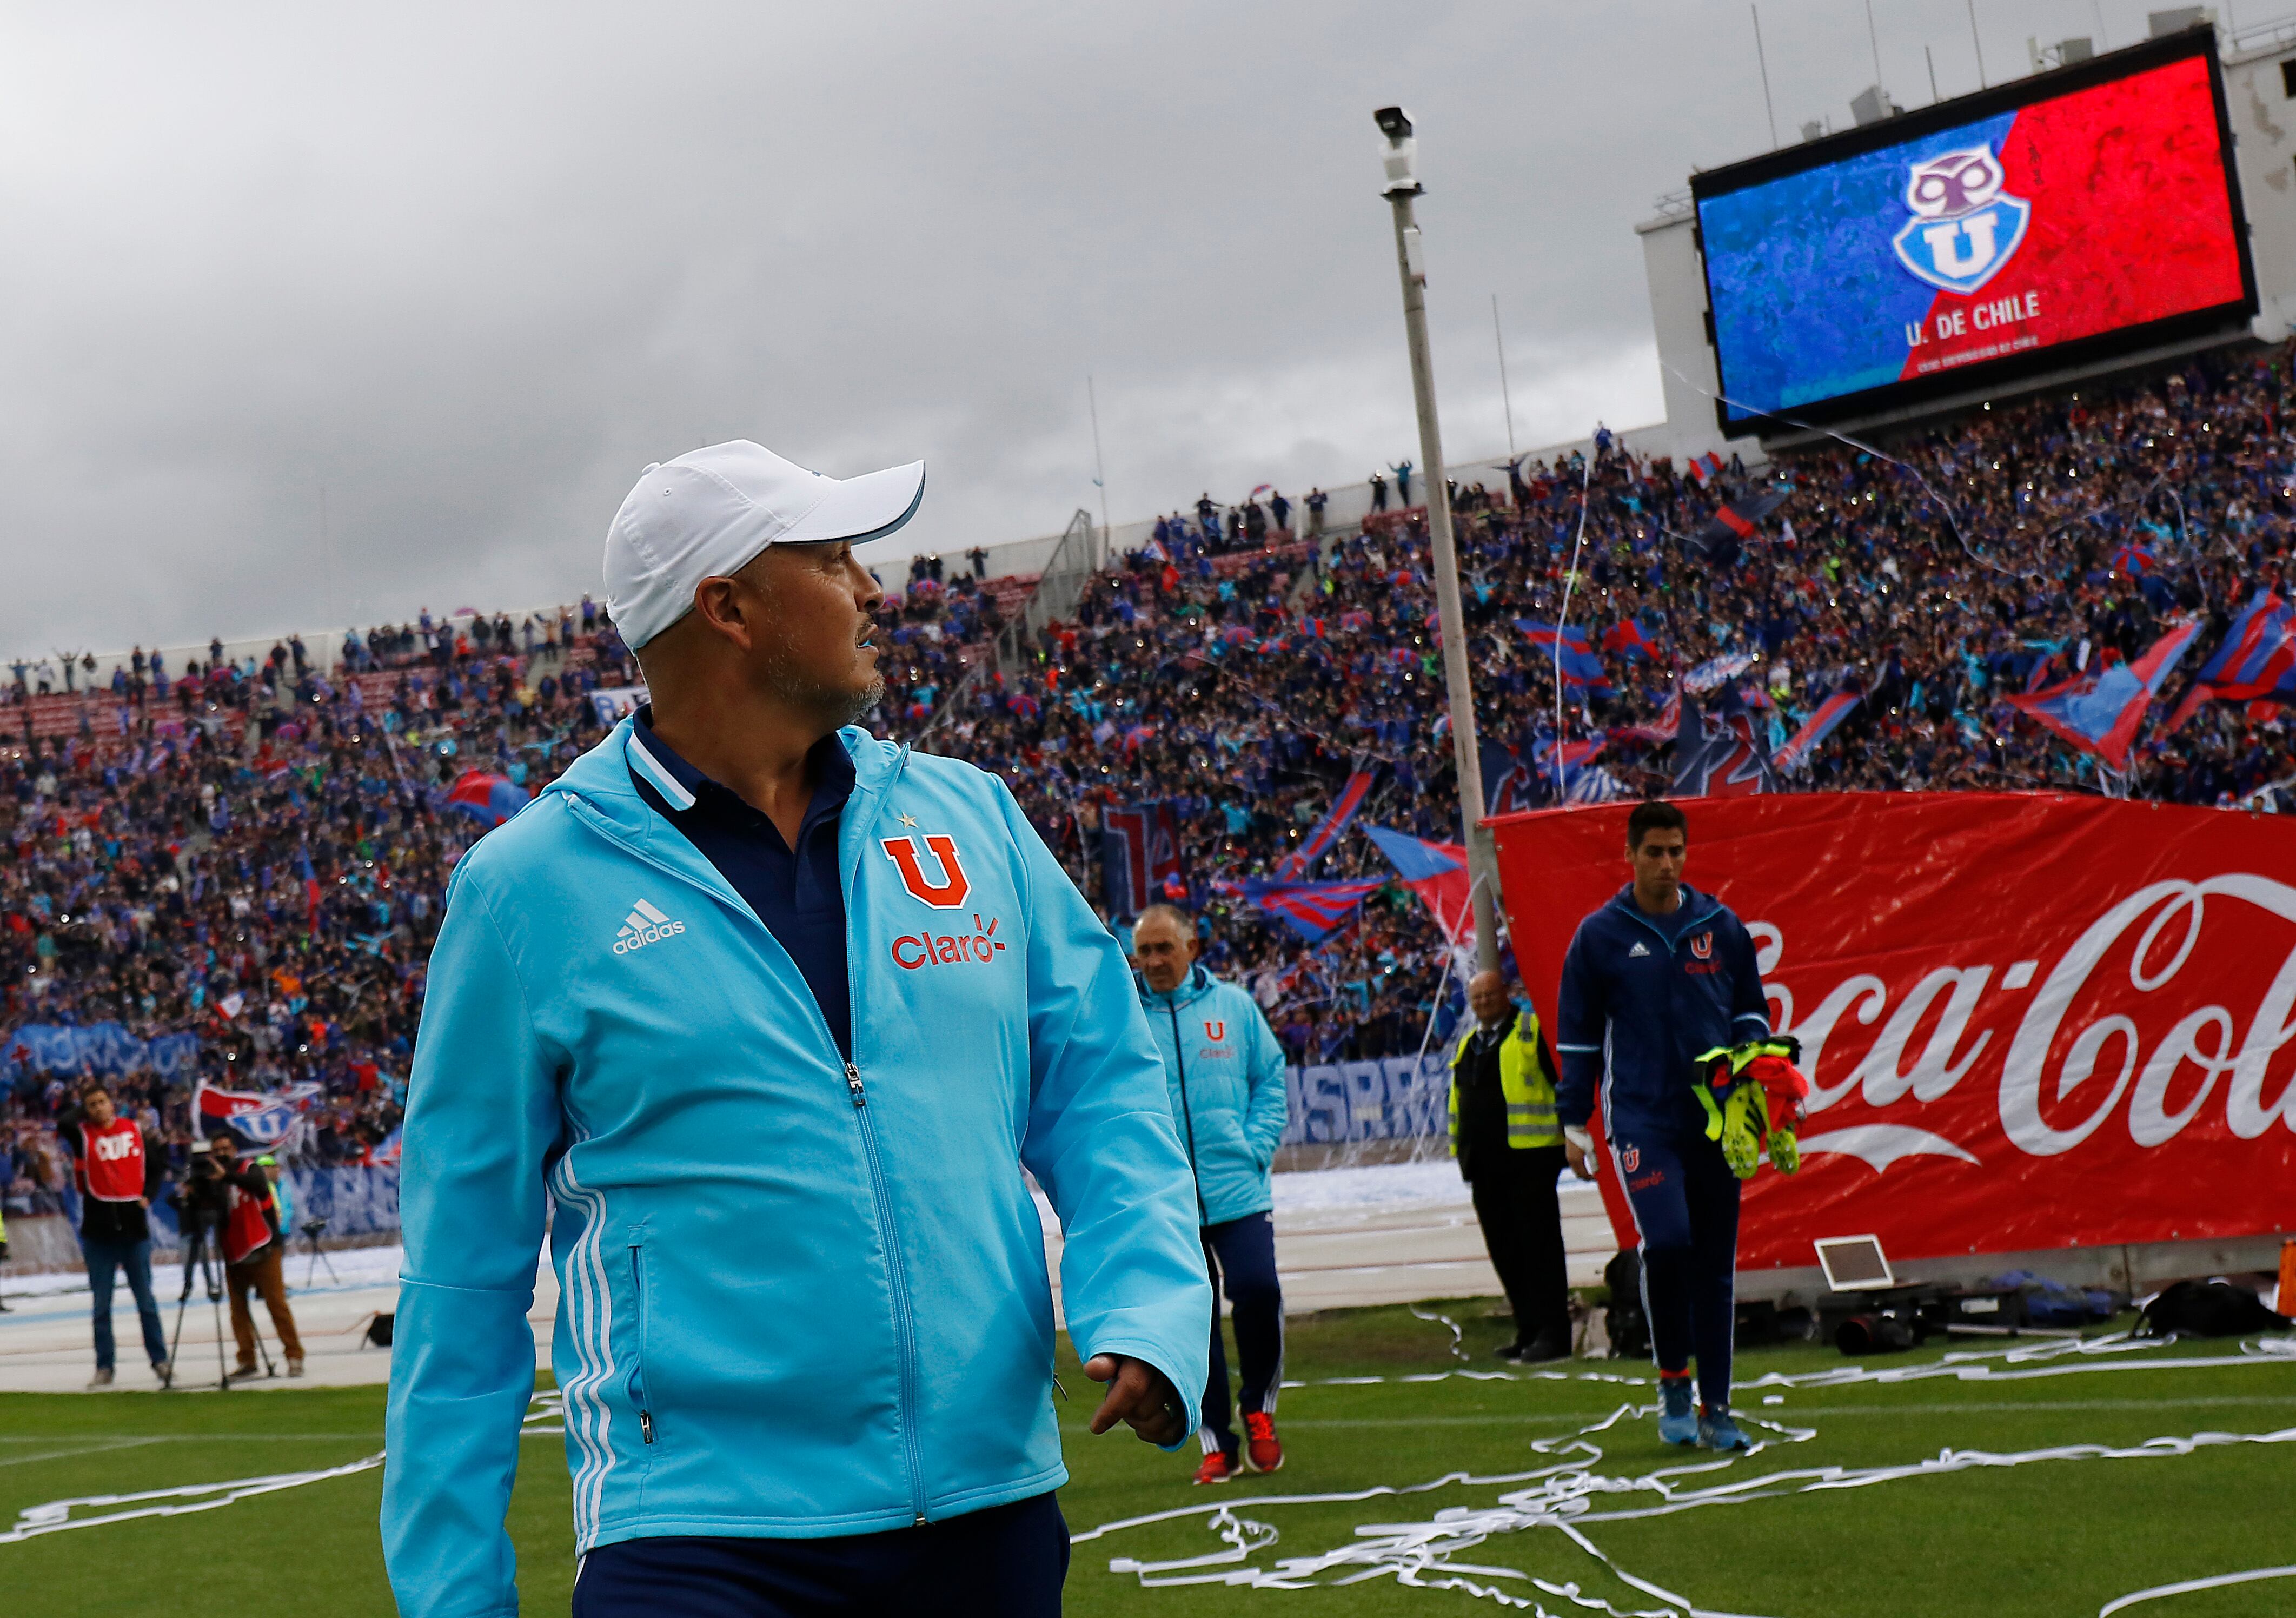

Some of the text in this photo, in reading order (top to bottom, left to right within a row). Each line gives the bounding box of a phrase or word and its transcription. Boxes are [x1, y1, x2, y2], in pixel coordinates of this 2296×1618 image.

[1923, 210, 1998, 279] U
[1905, 289, 2041, 347] U. DE CHILE
[879, 834, 972, 910] U
[612, 920, 686, 954] adidas
[891, 926, 996, 970] Claro
[1690, 931, 1714, 960] U
[1203, 1021, 1224, 1042] U
[1623, 1148, 1640, 1173] U
